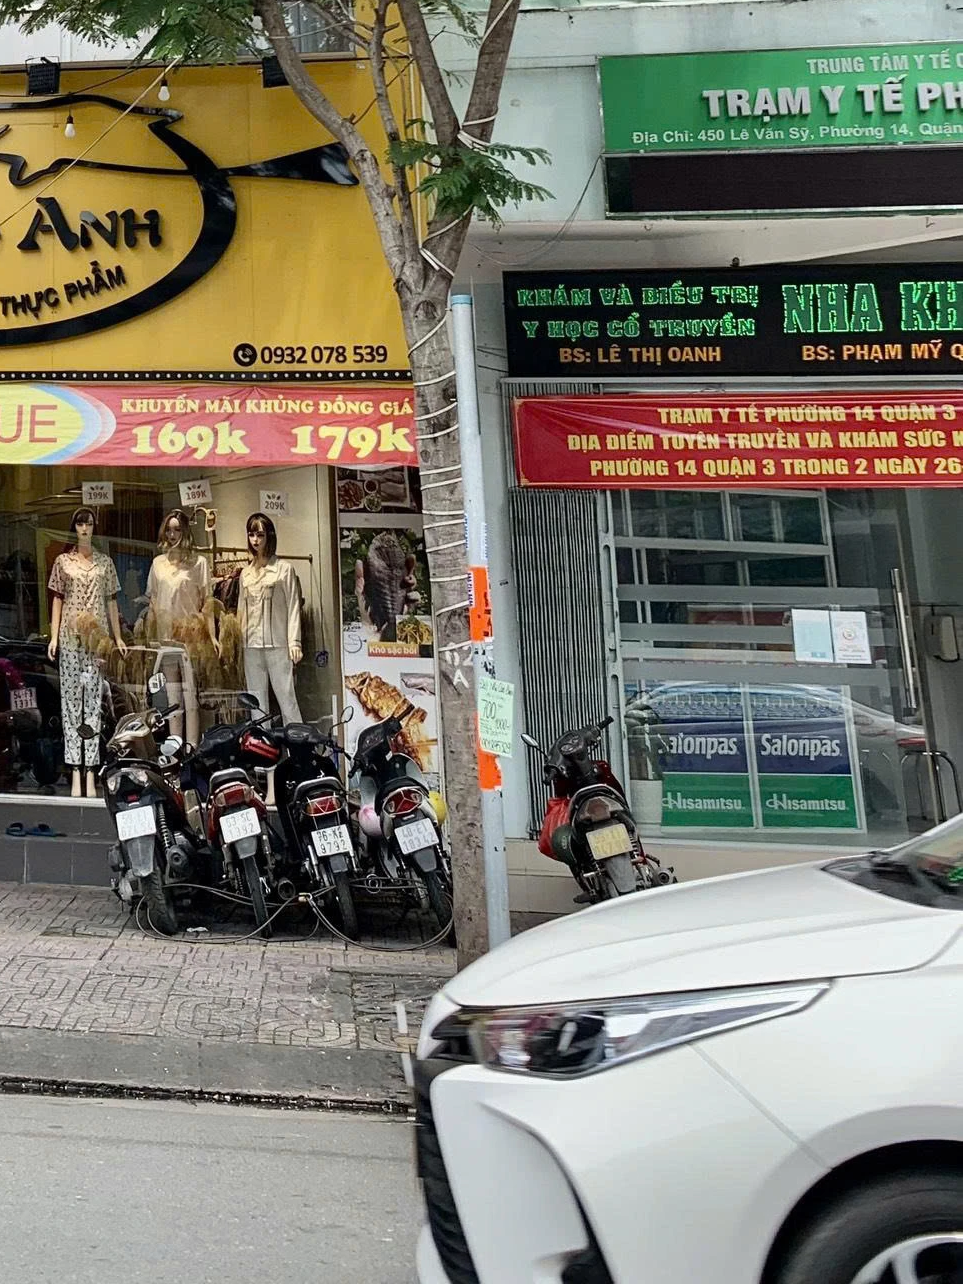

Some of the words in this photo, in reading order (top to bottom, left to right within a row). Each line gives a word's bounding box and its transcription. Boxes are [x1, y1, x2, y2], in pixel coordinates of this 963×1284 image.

[806, 56, 865, 74] TRUNG
[869, 53, 909, 71] TÂM
[913, 55, 925, 69] Y
[929, 48, 951, 69] TẾ
[701, 87, 811, 123] TRẠM
[820, 85, 845, 114] Y
[857, 73, 908, 113] TẾ
[632, 130, 658, 146] Địa
[697, 129, 725, 141] 450
[730, 127, 749, 140] Lê
[754, 126, 784, 140] Văn
[819, 124, 885, 139] Phường
[890, 123, 913, 136] 14,
[63, 260, 127, 304] PHẨM
[599, 283, 634, 306] VÀ
[782, 283, 883, 333] NHA
[522, 320, 539, 338] Y
[547, 320, 598, 342] HỌC
[260, 345, 307, 364] 0932
[311, 345, 347, 364] 078
[352, 345, 388, 363] 539
[559, 347, 591, 363] BS:
[597, 343, 621, 363] LÊ
[628, 347, 662, 365] THỊ
[668, 346, 722, 363] OANH
[802, 345, 835, 361] BS:
[842, 343, 902, 363] PHẠM
[911, 339, 942, 359] MỸ
[204, 397, 241, 415] MÃI
[245, 394, 314, 415] KHỦNG
[318, 395, 374, 415] ĐỒNG
[657, 408, 714, 426] TRẠM
[718, 408, 730, 423] Y
[736, 403, 759, 423] TẾ
[764, 403, 846, 422] PHƯỜNG
[852, 406, 875, 421] 14
[880, 403, 937, 423] QUẬN
[942, 404, 956, 420] 3
[567, 434, 601, 452] ĐỊA
[605, 428, 654, 450] ĐIỂM
[659, 431, 721, 450] TUYÊN
[725, 427, 800, 449] TRUYỀN
[805, 429, 833, 448] VÀ
[838, 428, 898, 448] KHÁM
[904, 428, 946, 447] SỨC
[590, 457, 669, 476] PHƯỜNG
[674, 459, 697, 476] 14
[703, 456, 756, 478] QUẬN
[762, 459, 775, 475] 3
[781, 458, 849, 475] TRONG
[855, 458, 868, 475] 2
[874, 455, 927, 474] NGÀY
[658, 732, 737, 760] alonpas
[760, 733, 841, 761] Salonpas
[766, 793, 847, 811] Hisamitsu
